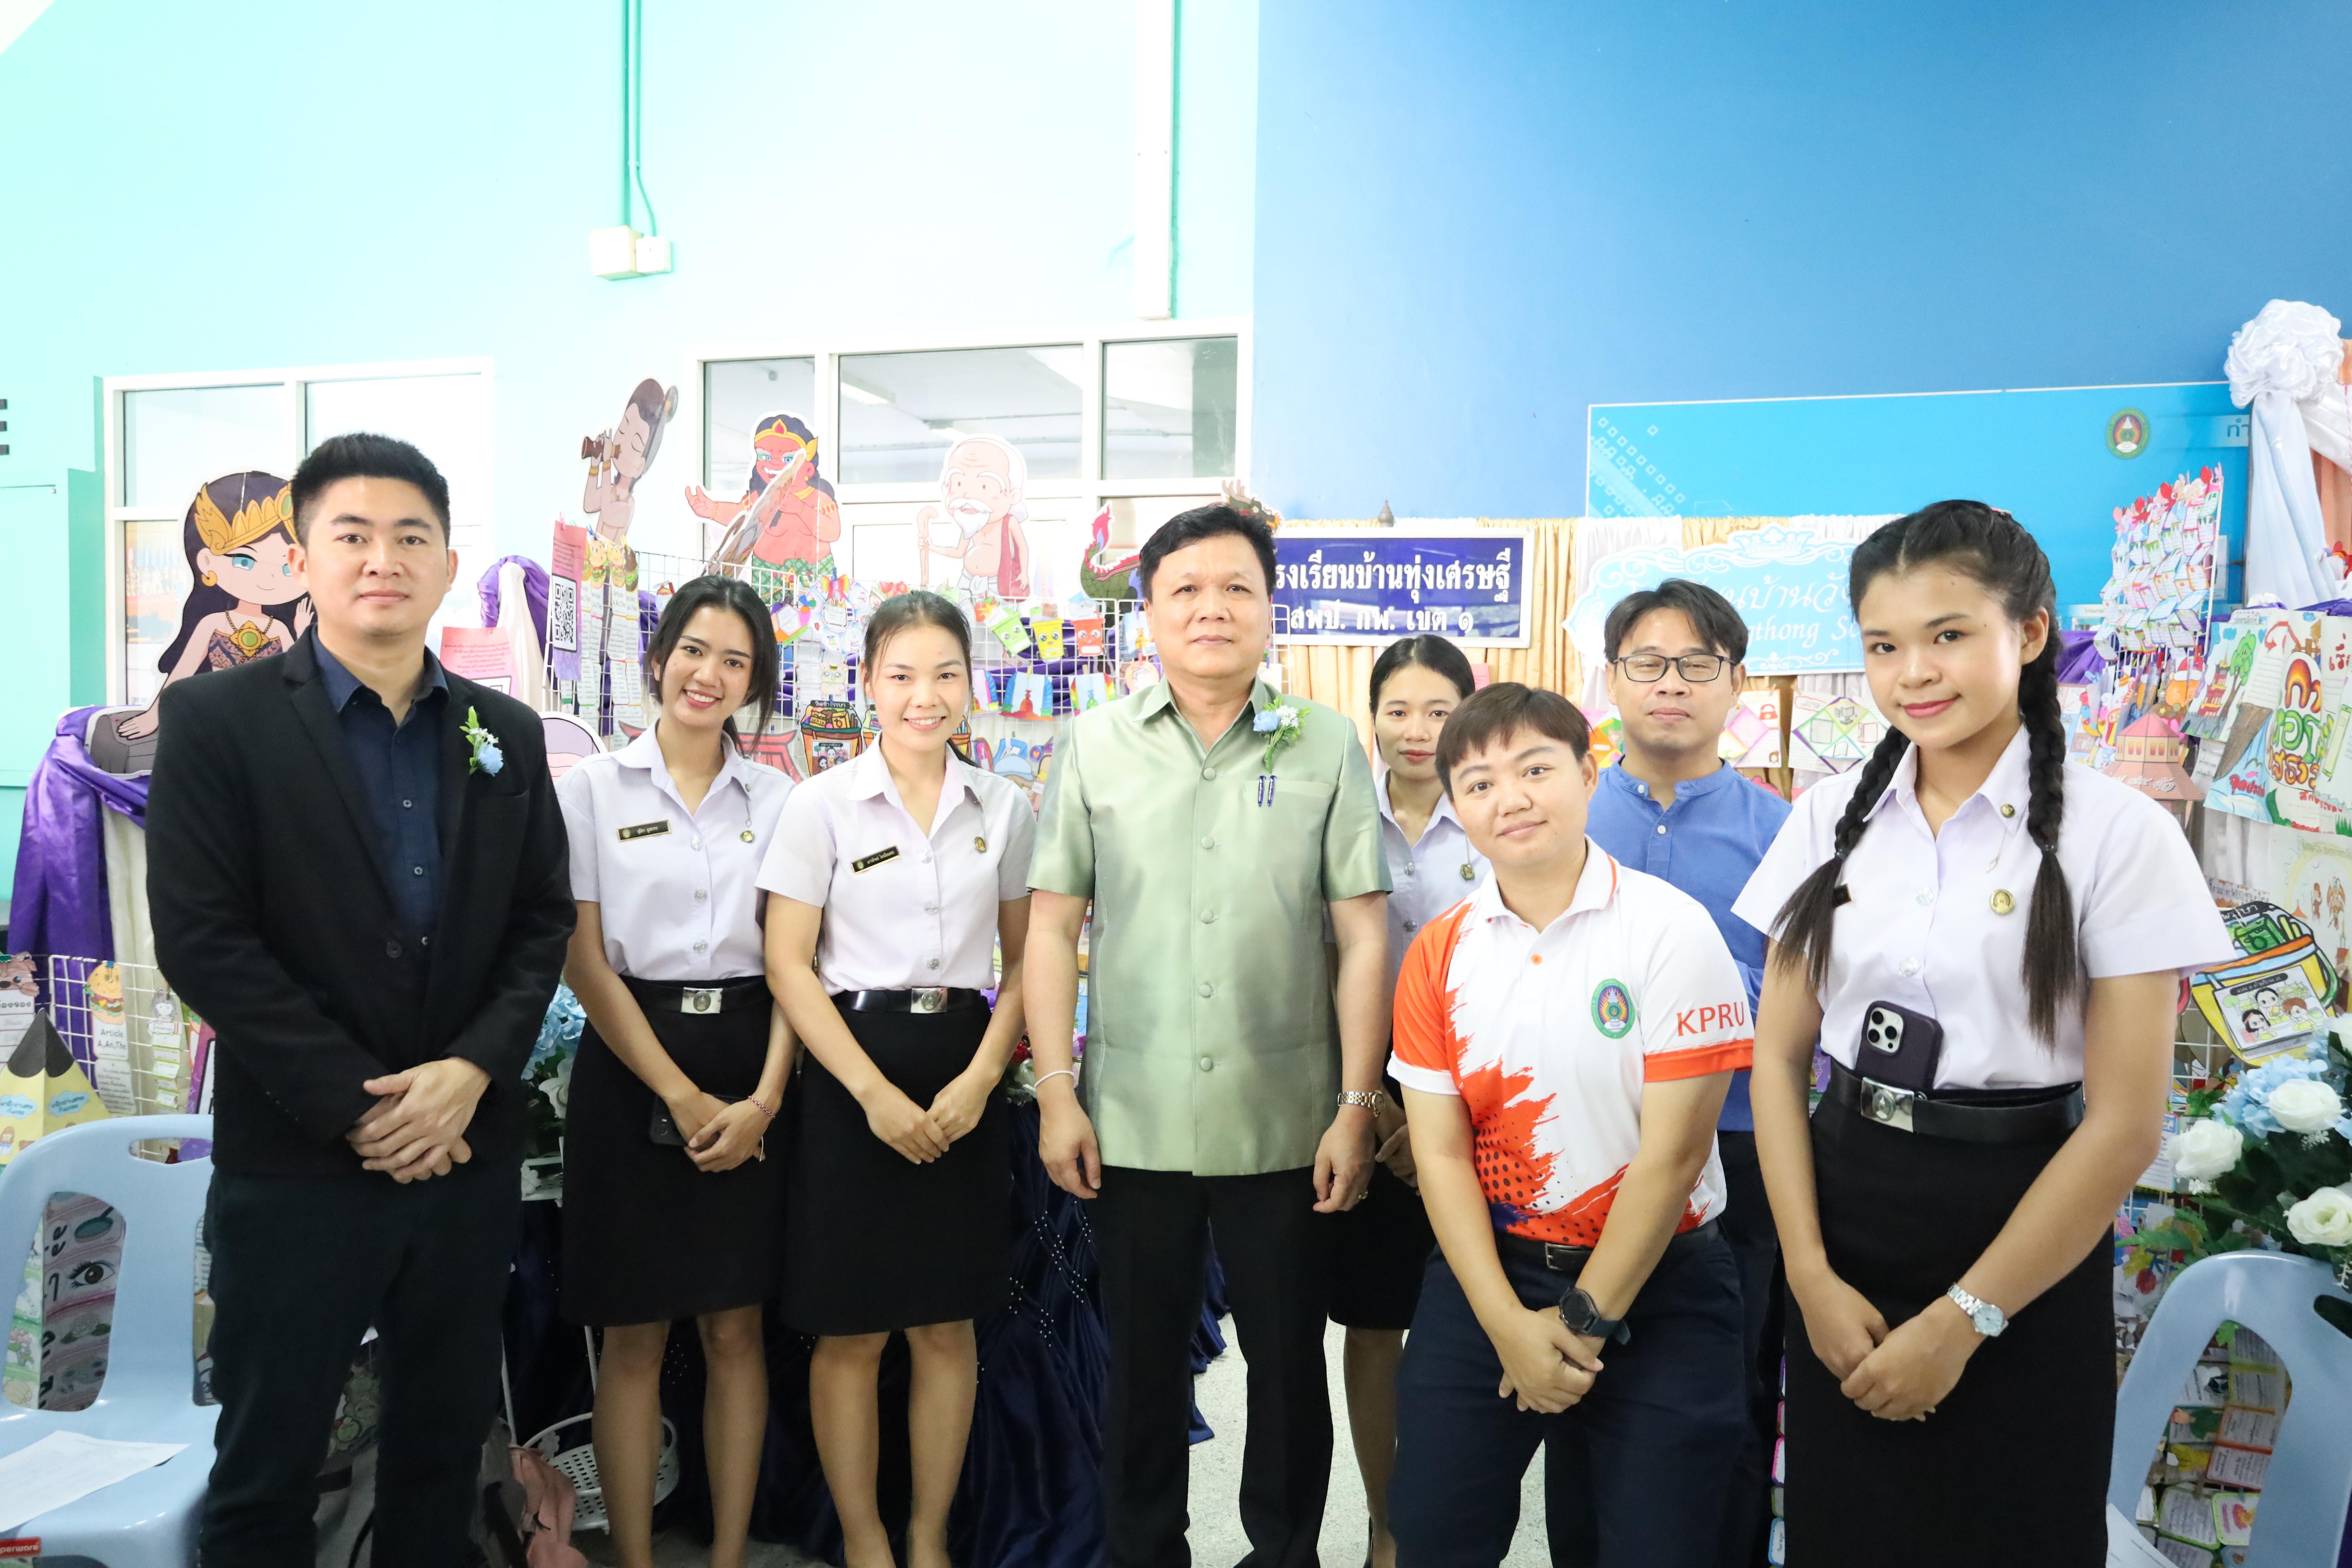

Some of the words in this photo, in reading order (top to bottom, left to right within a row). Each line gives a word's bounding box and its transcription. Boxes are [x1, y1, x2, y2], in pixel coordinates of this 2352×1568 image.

[1275, 547, 1511, 603] รงเรียนบ้านทุ่งเศรษฐี
[1720, 572, 1851, 613] นบ้านวั
[1290, 599, 1346, 630] สพป.
[1357, 609, 1395, 631] กพ.
[1407, 610, 1447, 631] เขต
[1458, 611, 1474, 633] ๑
[100, 1028, 124, 1038] Article
[1677, 1001, 1745, 1037] KPRU
[0, 1544, 39, 1554] perware
